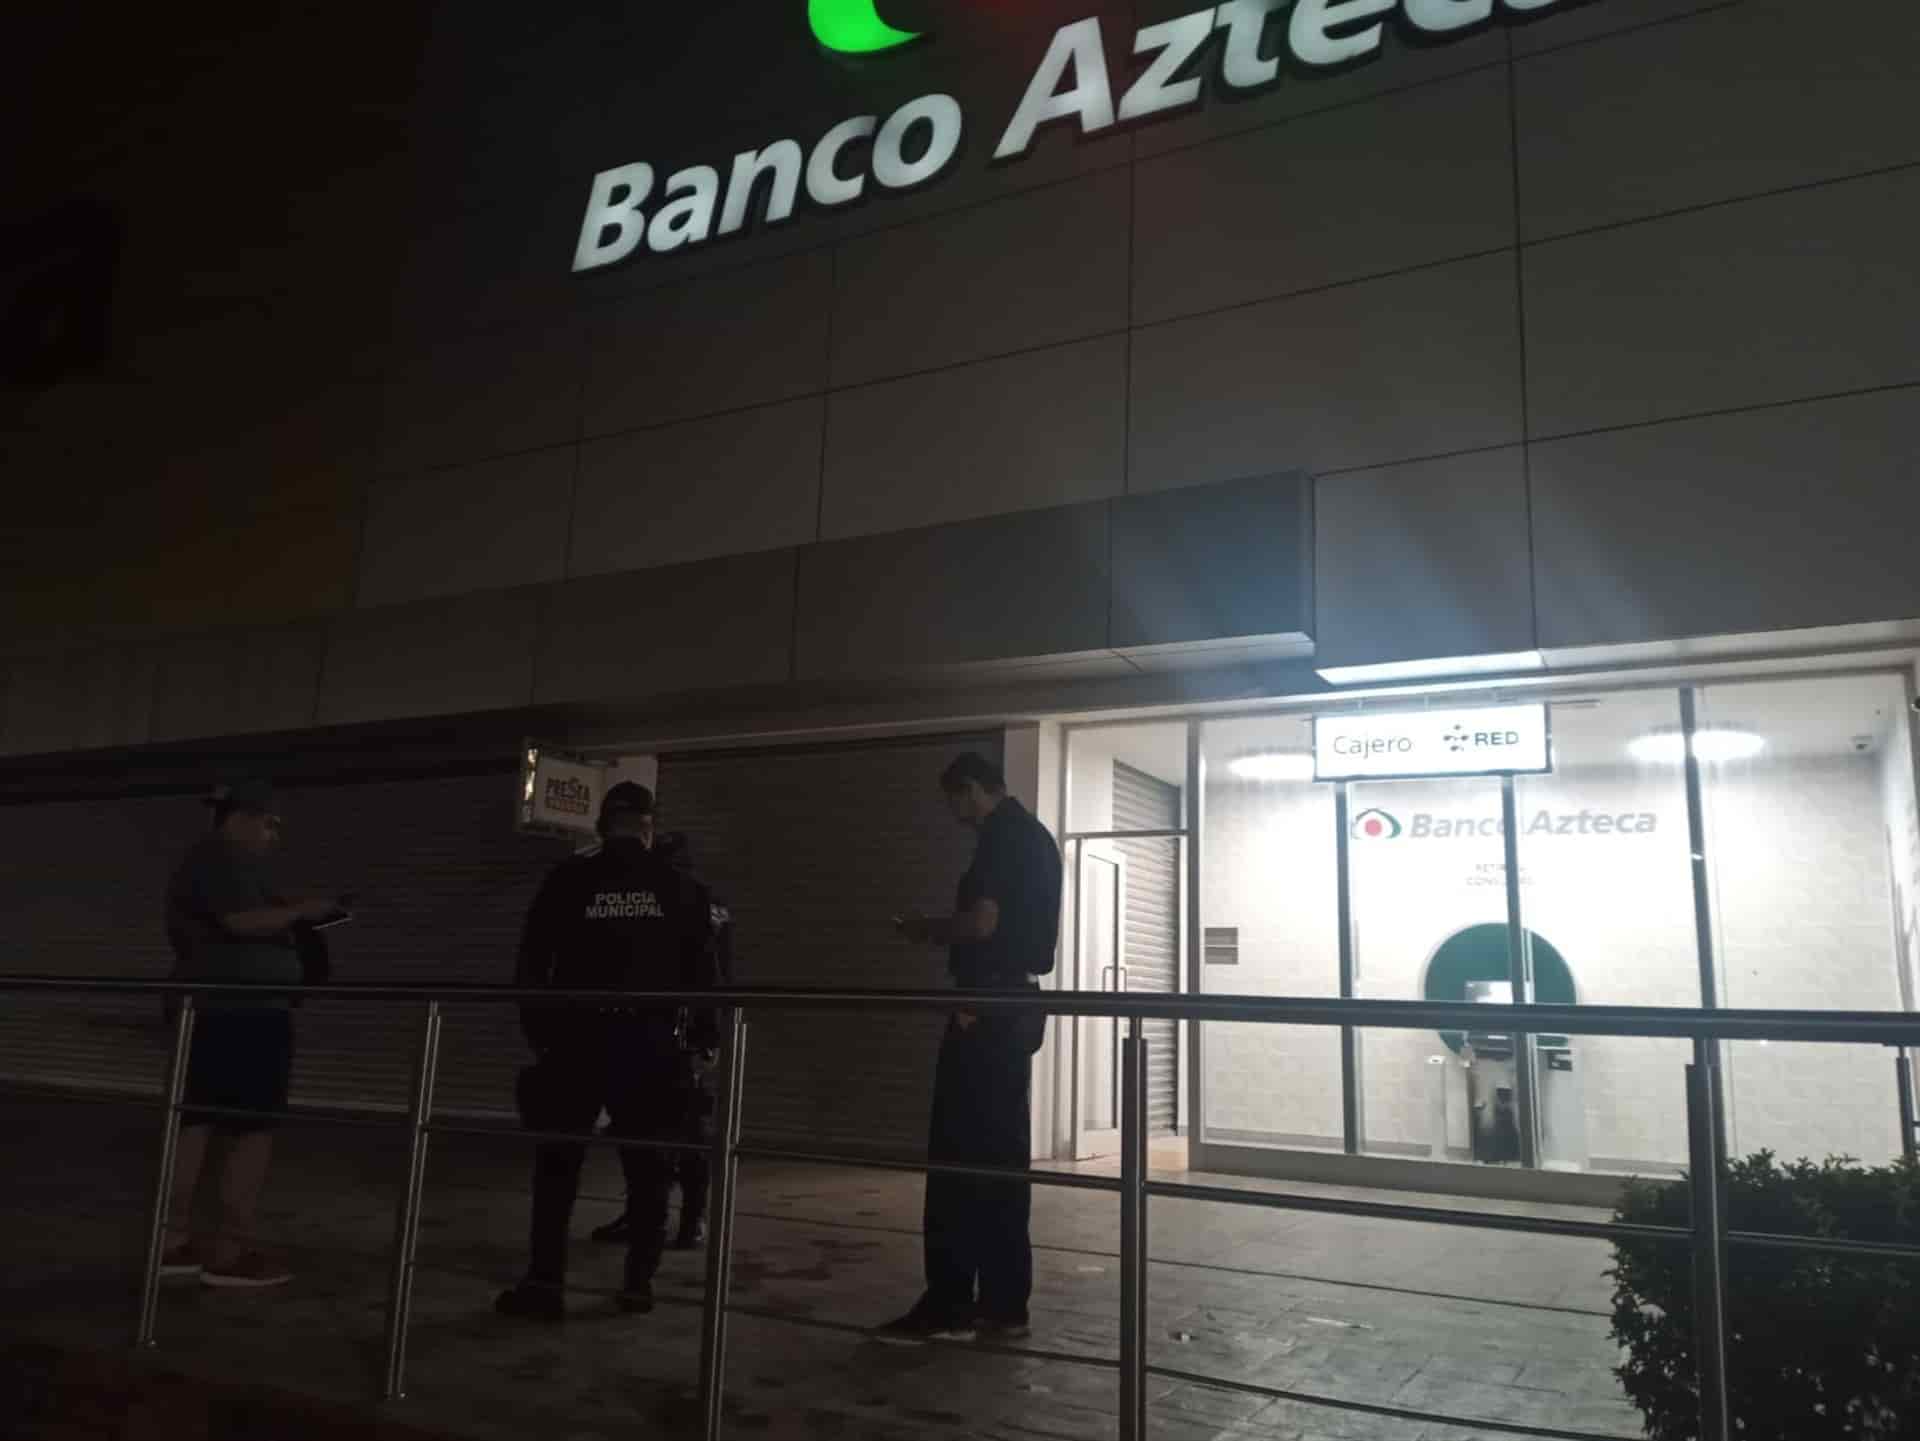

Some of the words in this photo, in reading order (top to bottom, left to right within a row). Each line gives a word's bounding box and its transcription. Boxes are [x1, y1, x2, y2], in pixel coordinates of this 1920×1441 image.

[571, 92, 963, 273] Banco
[993, 0, 1559, 160] Azte
[1333, 735, 1412, 759] Cajero
[1474, 730, 1519, 746] RED
[1525, 809, 1657, 835] Azteca
[584, 903, 664, 920] MUNICIPAL
